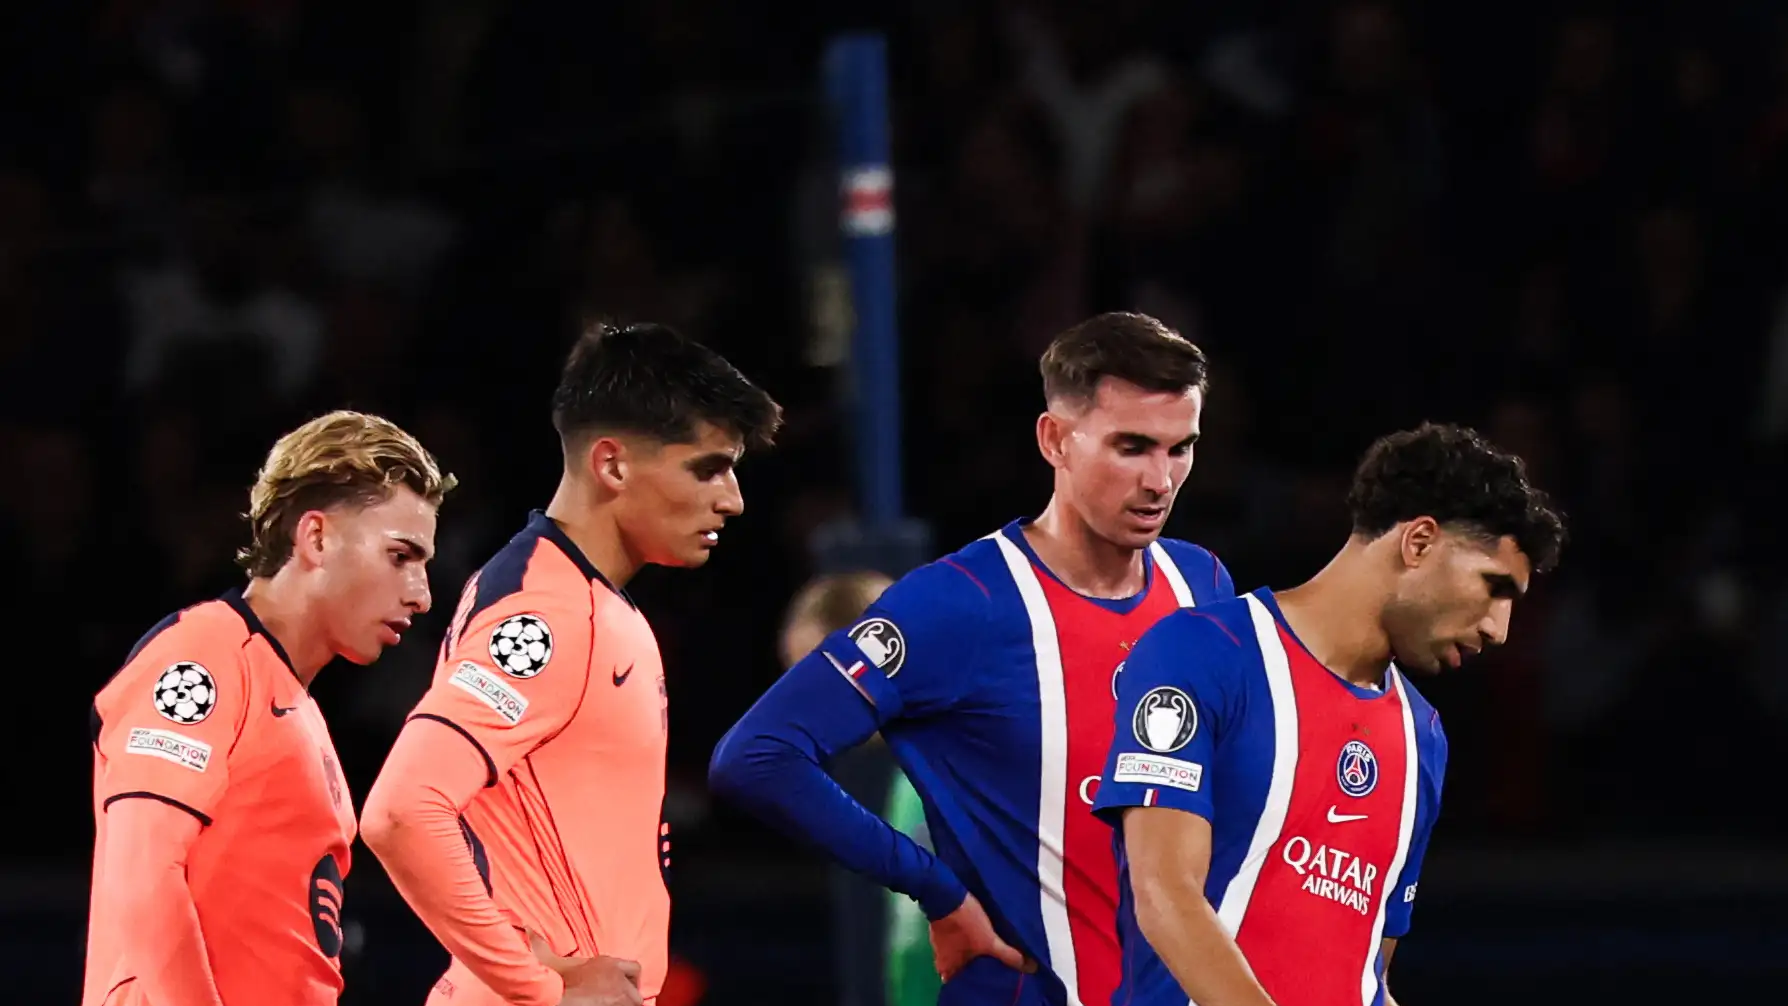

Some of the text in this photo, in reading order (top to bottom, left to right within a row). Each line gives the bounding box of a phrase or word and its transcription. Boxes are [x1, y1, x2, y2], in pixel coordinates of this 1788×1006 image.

[457, 667, 523, 717] FOUNDATION
[130, 735, 208, 763] FOUNDATION
[1119, 762, 1198, 781] FOUNDATION
[1283, 836, 1378, 896] QATAR
[1301, 873, 1371, 916] AIRWAYS
